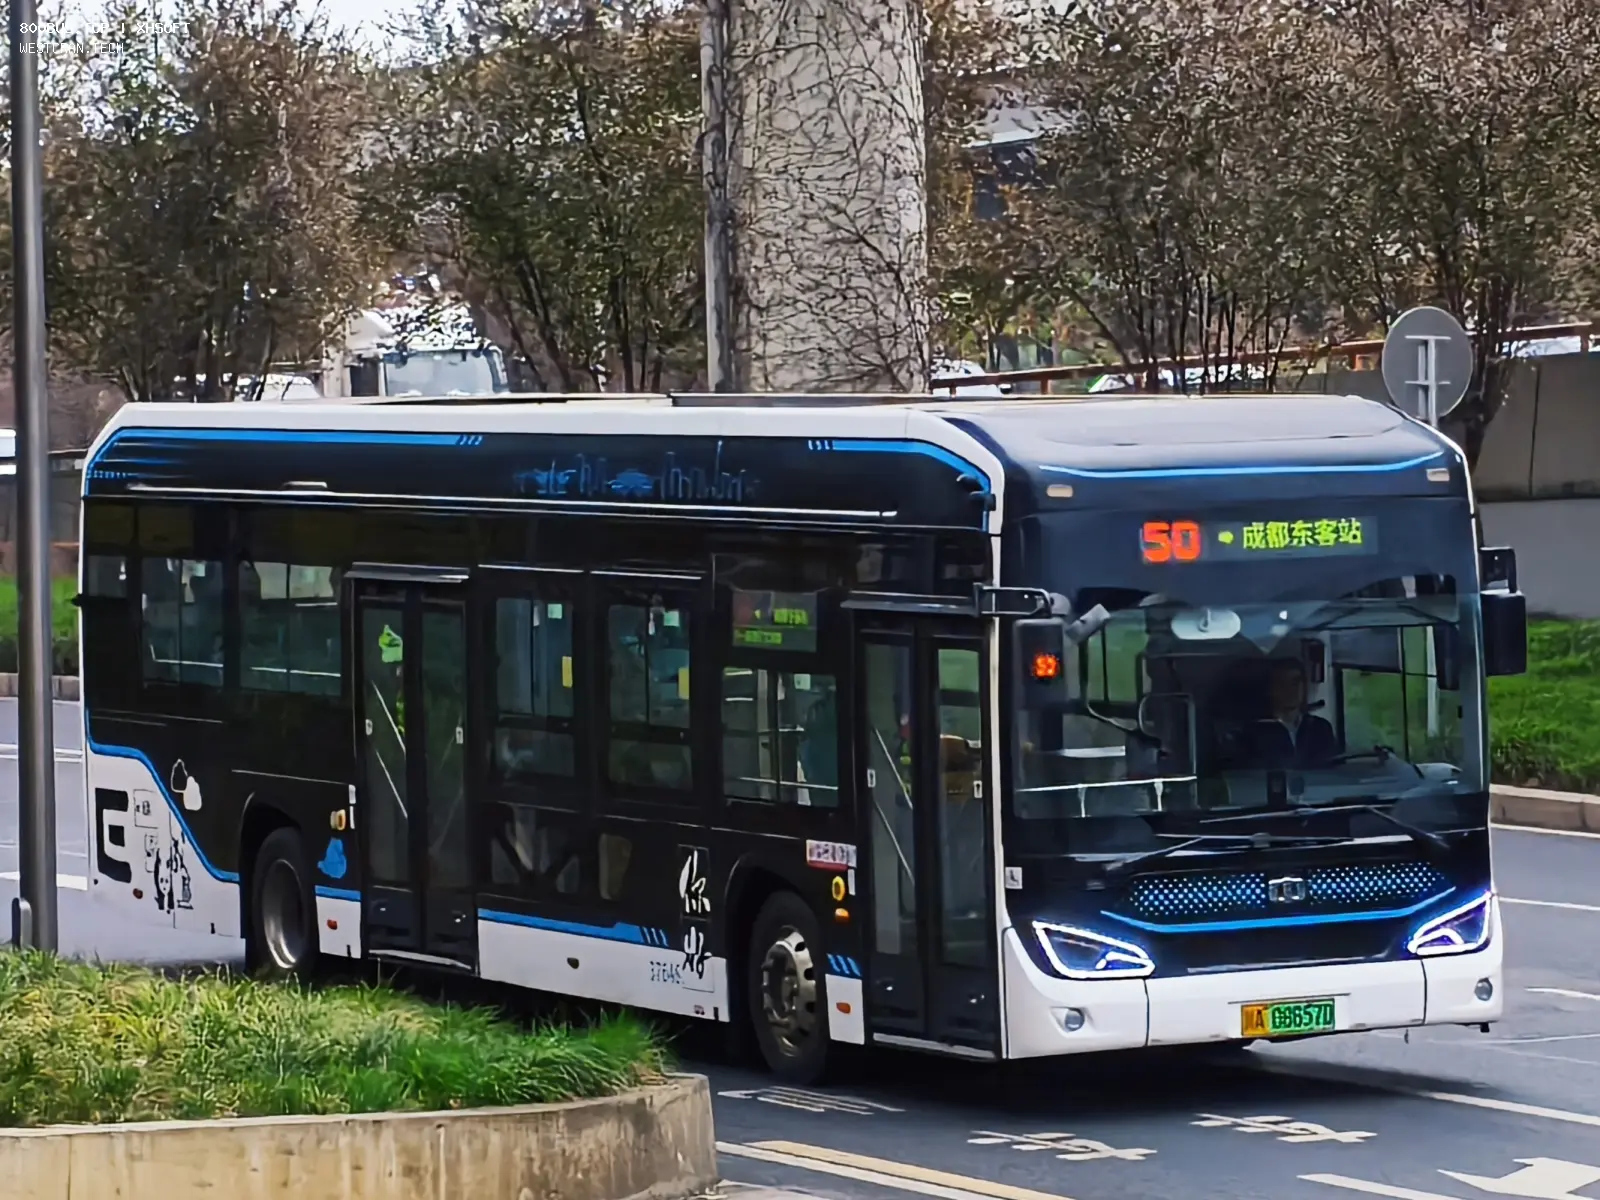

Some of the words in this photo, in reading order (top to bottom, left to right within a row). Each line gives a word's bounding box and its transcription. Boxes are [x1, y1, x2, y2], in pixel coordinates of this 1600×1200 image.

[1142, 520, 1201, 563] 50
[1243, 517, 1362, 549] 成都东客站
